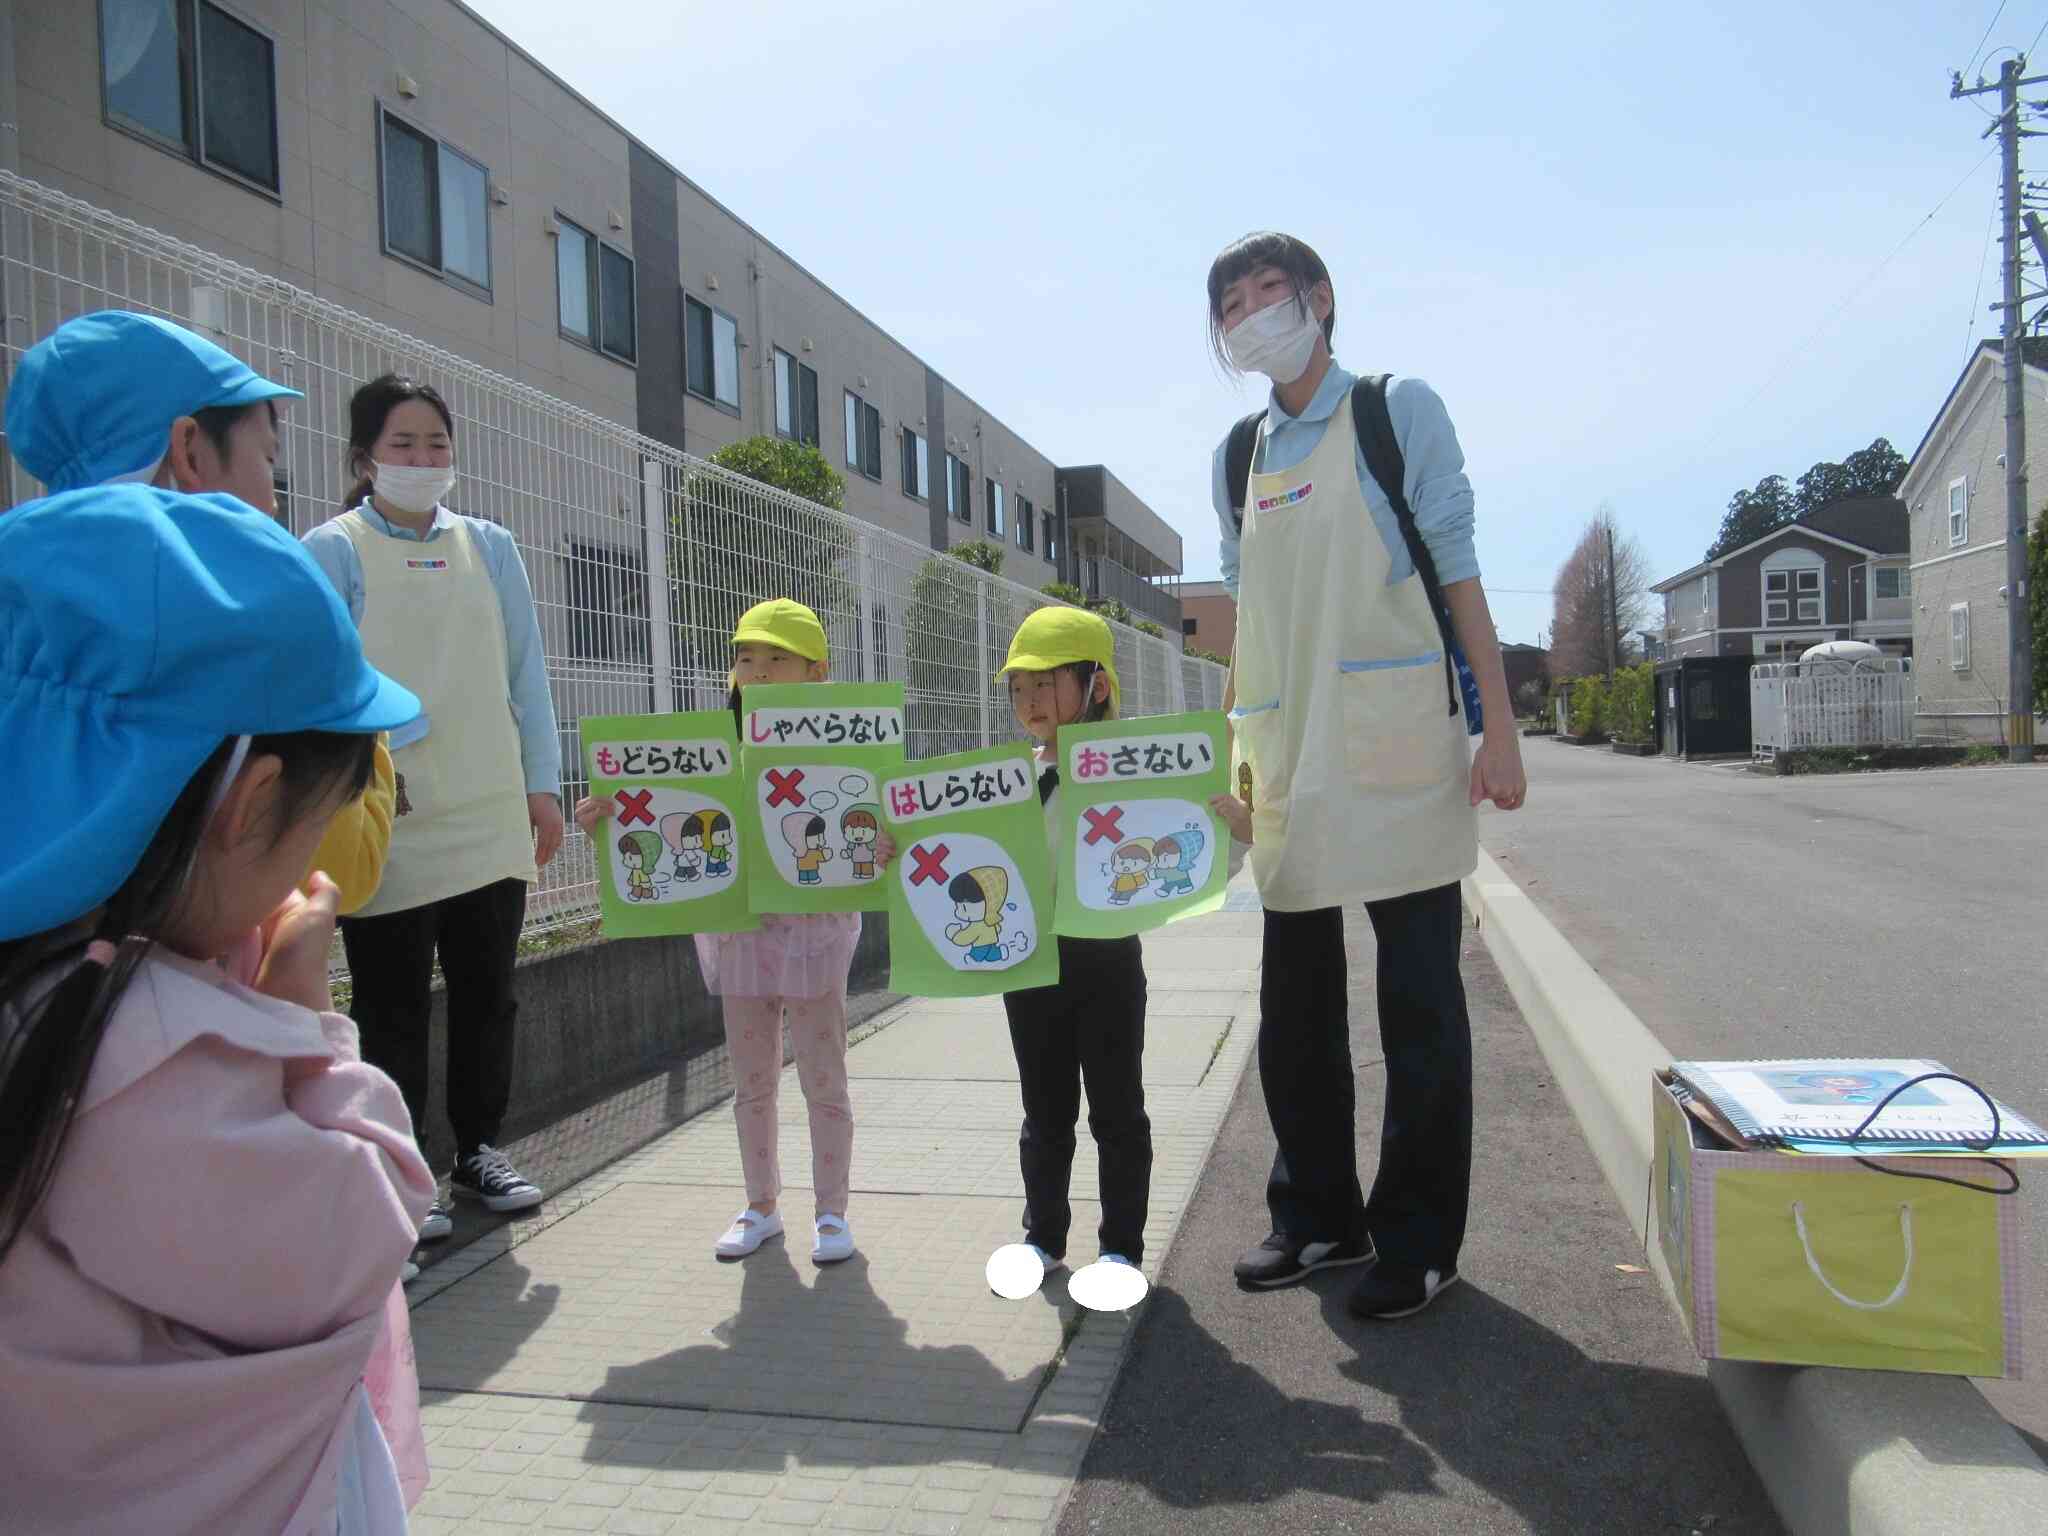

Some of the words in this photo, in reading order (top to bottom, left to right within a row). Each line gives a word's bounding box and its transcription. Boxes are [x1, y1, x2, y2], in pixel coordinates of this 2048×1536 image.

[751, 712, 900, 744] しゃべらない
[596, 745, 728, 776] もどらない
[1077, 743, 1211, 778] おさない
[891, 767, 1026, 817] はしらない
